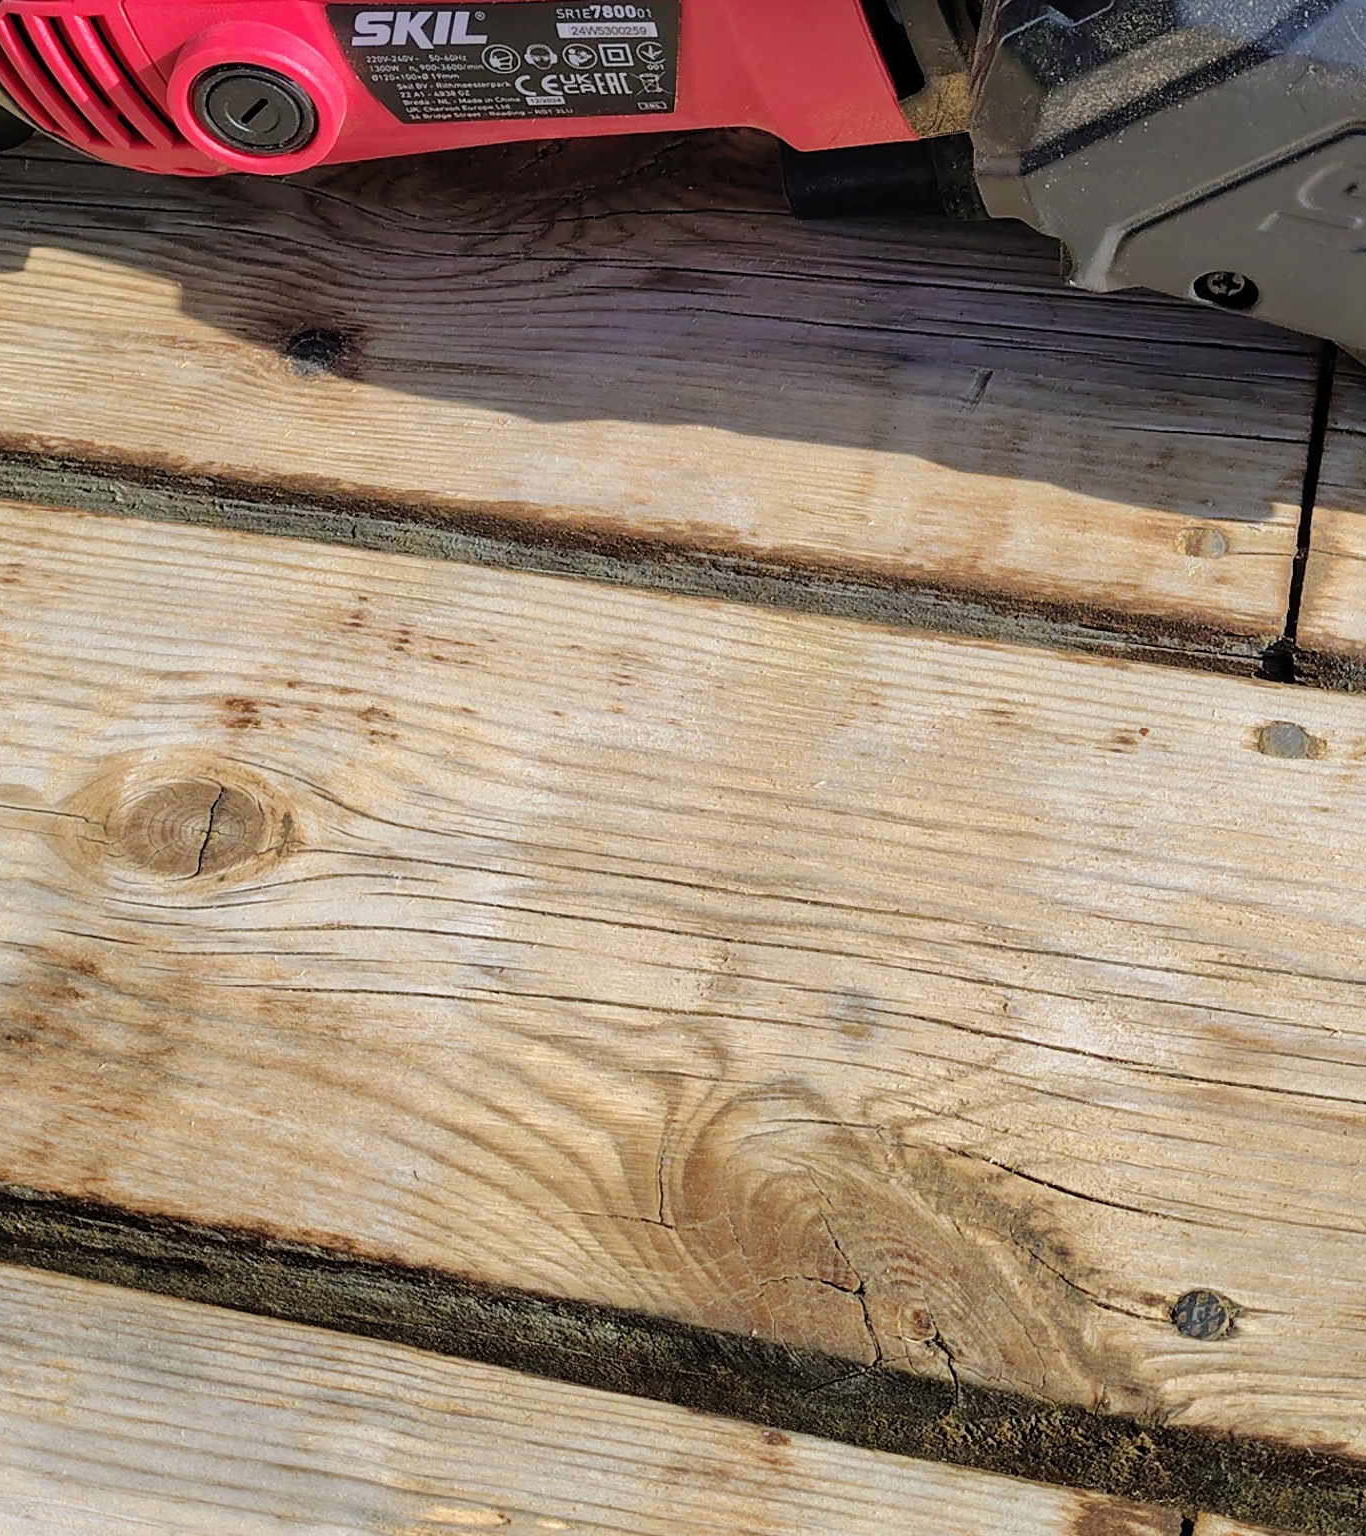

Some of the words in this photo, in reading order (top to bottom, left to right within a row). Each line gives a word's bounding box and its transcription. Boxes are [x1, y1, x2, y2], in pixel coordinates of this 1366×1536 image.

[351, 11, 488, 49] SKIL
[571, 26, 647, 36] 24W5300259
[428, 54, 467, 62] 50-60Hz
[514, 74, 563, 96] CE
